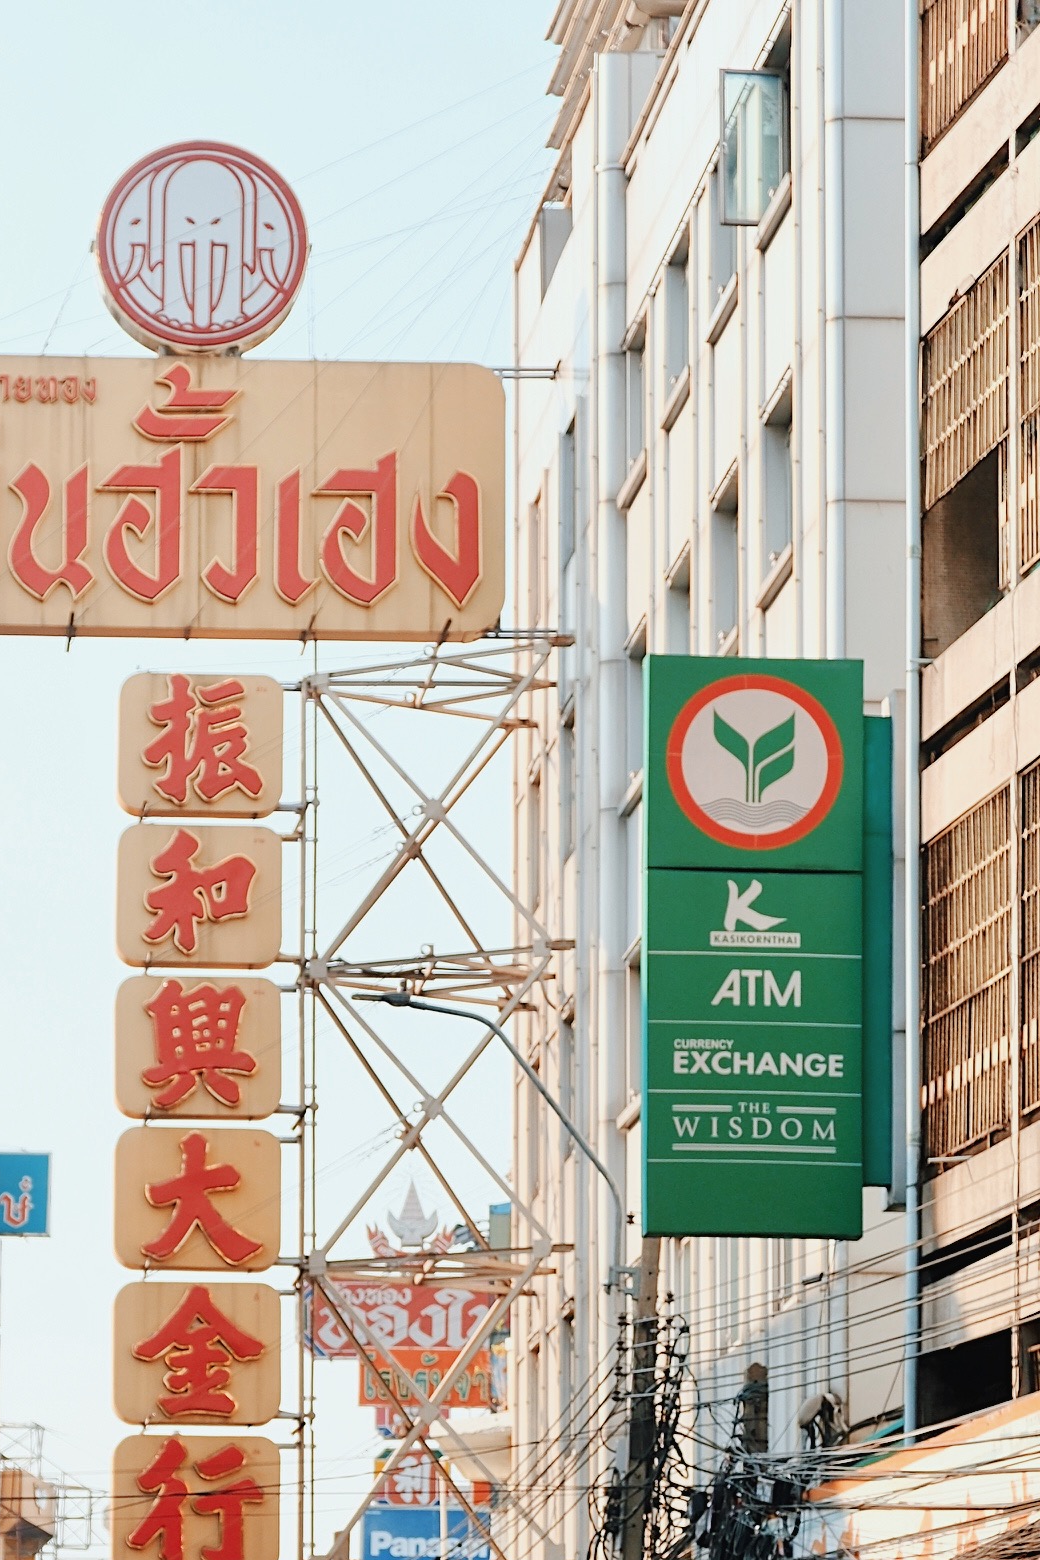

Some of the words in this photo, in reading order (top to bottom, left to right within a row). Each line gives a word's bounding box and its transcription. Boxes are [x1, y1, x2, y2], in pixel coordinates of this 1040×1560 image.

[724, 878, 788, 932] K
[713, 934, 798, 946] KASIKORNTHAI
[711, 968, 802, 1008] ATM
[673, 1038, 735, 1050] CURRENCY
[673, 1050, 844, 1078] EXCHANGE
[738, 1101, 771, 1115] THE
[672, 1116, 837, 1142] WISDOM
